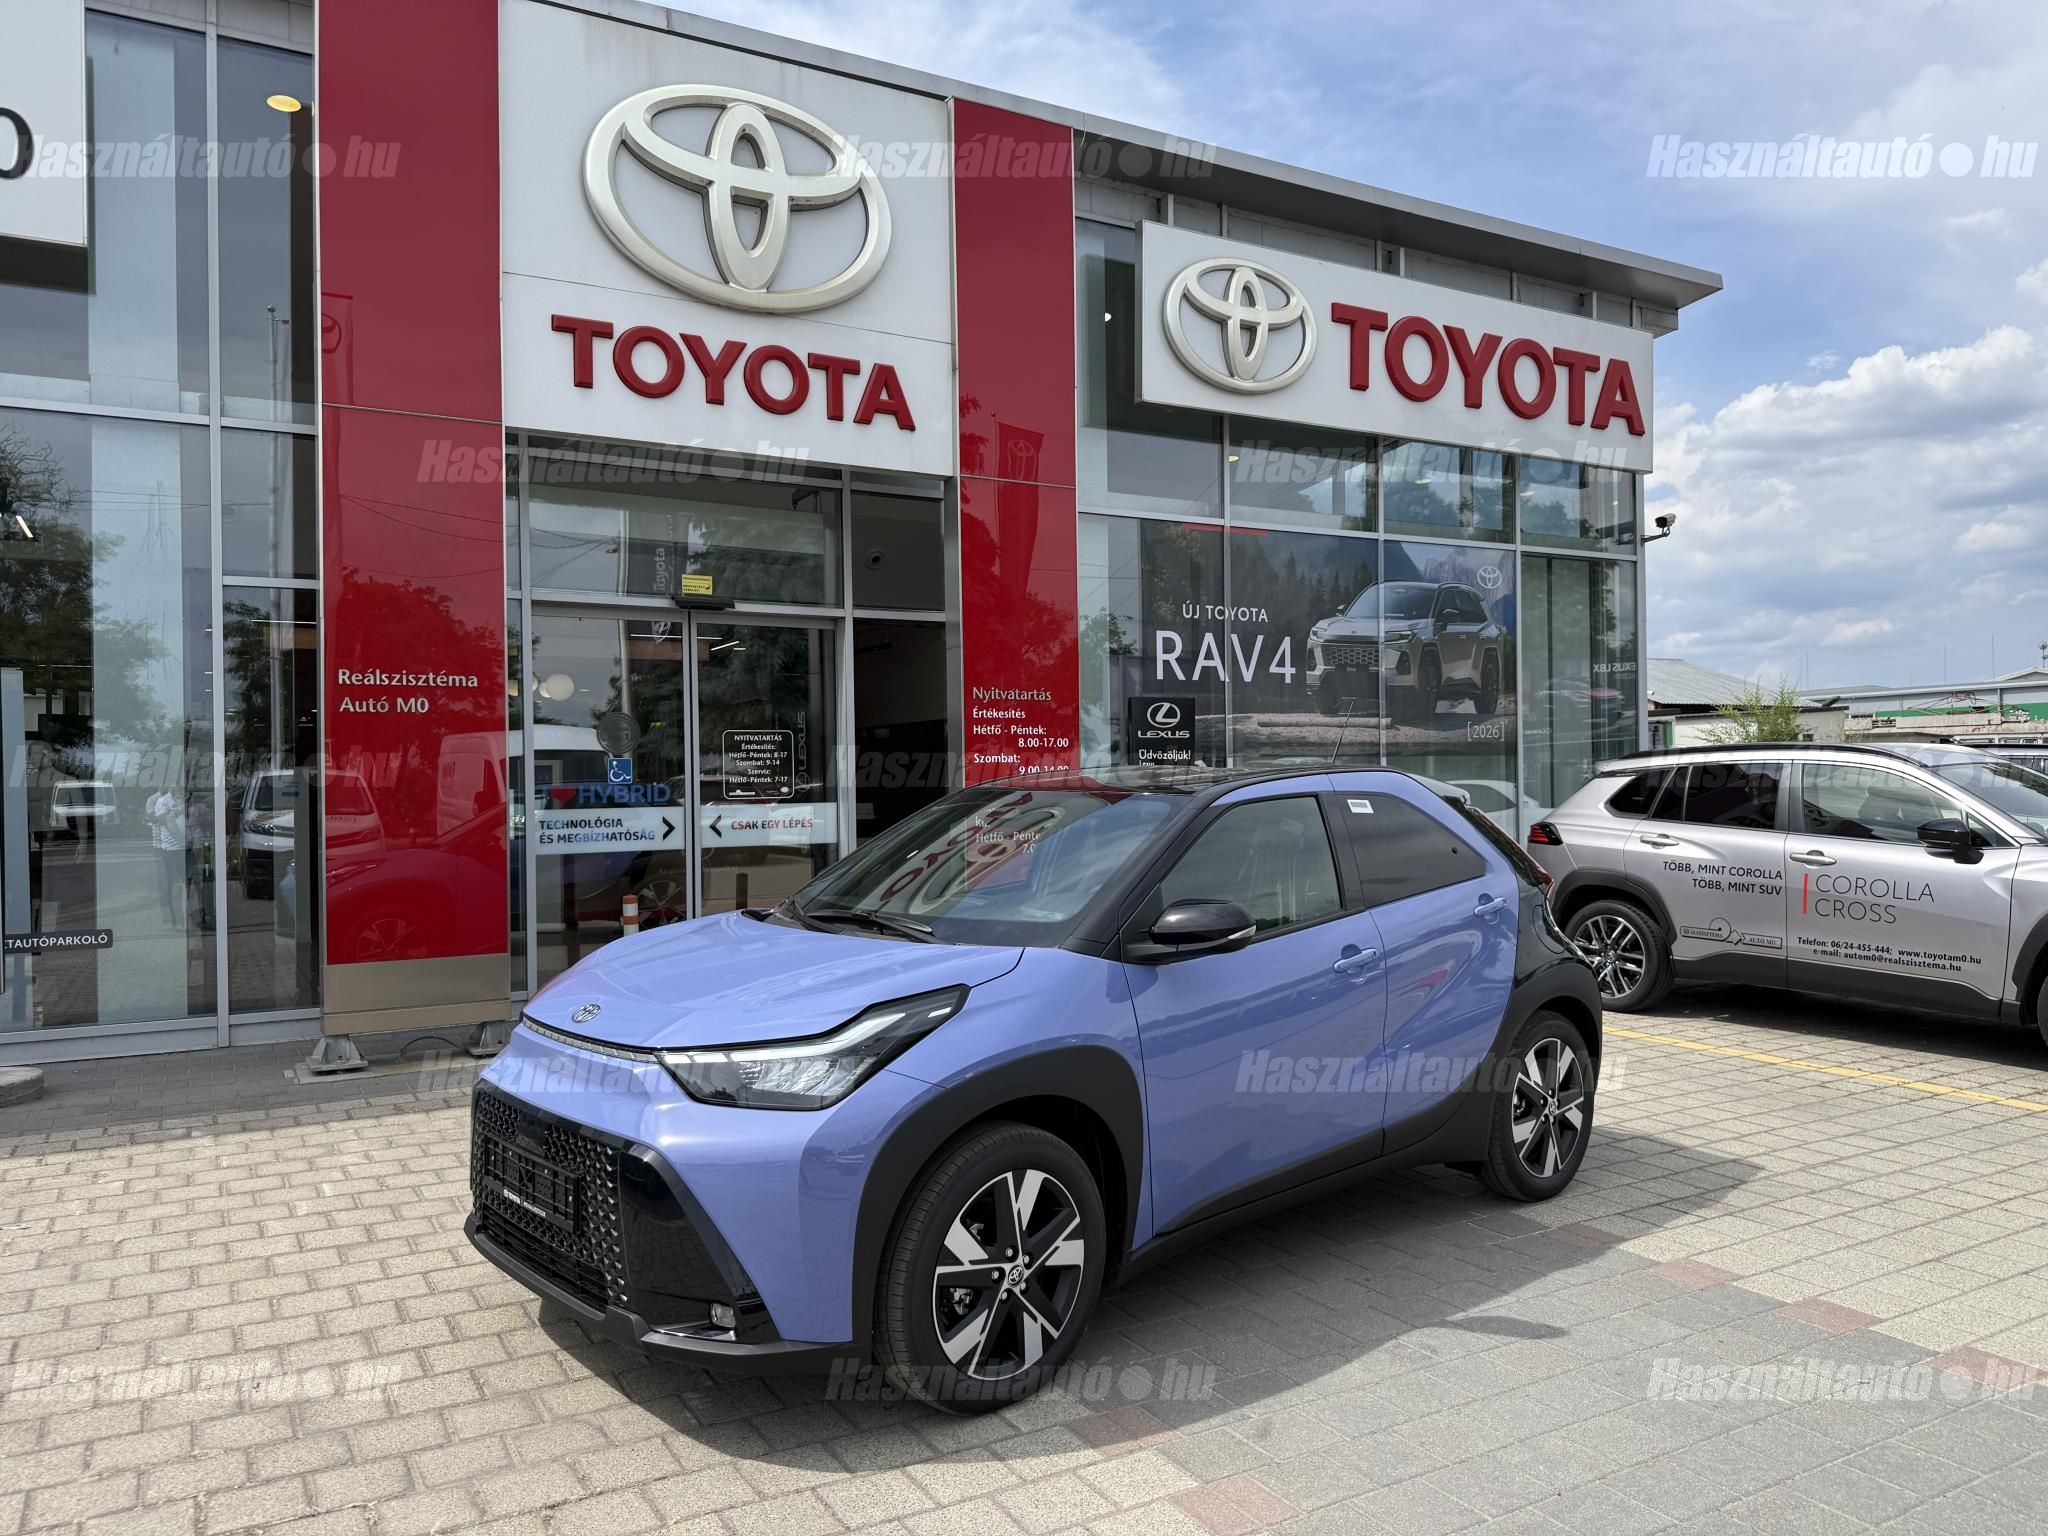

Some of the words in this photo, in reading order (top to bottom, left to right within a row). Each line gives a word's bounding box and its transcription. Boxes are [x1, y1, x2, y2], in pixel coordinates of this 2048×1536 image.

[551, 313, 916, 432] TOYOTA
[1331, 302, 1645, 436] TOYOTA
[1182, 600, 1200, 619] ÚJ
[1205, 604, 1268, 623] TOYOTA
[1156, 630, 1296, 684] RAV4
[338, 668, 478, 687] Reálszisztéma
[973, 686, 1052, 703] Nyitvatartás
[339, 696, 389, 713] Autó
[396, 697, 429, 713] M0
[973, 706, 1026, 719] Értékesítés
[734, 733, 783, 741] NYITVATARTÁS
[973, 724, 1002, 735] Hétfő
[1010, 724, 1047, 735] Péntek:
[1137, 730, 1190, 738] LEXUS
[1018, 738, 1069, 748] 8.00-17.00
[973, 753, 1021, 763] Szombat:
[1138, 749, 1191, 761] Üdvözöljük!
[579, 782, 672, 804] HYBRID
[539, 816, 624, 830] TECHNOLÓGIA
[731, 820, 759, 830] CSAK
[761, 819, 780, 829] EGY
[783, 817, 814, 829] LÉPÉS
[539, 832, 554, 844] ÉS
[557, 828, 656, 844] MEGBÍZHATÓSÁG
[1663, 860, 1694, 874] TÖBB,
[1698, 864, 1727, 876] MINT
[1728, 866, 1783, 880] COROLLA
[1692, 877, 1724, 892] TÖBB,
[1727, 882, 1757, 893] MINT
[1758, 884, 1782, 895] SUV
[1815, 874, 1934, 903] COROLLA
[1815, 898, 1897, 924] CROSS
[1797, 936, 1829, 948] Telefon:
[1830, 940, 1893, 955] 06/24-455-444;
[1898, 949, 1982, 965] www.toyotam0.hu
[1813, 948, 1842, 958] e-mail:
[1844, 951, 1962, 972] autom0@realszisztema.hu
